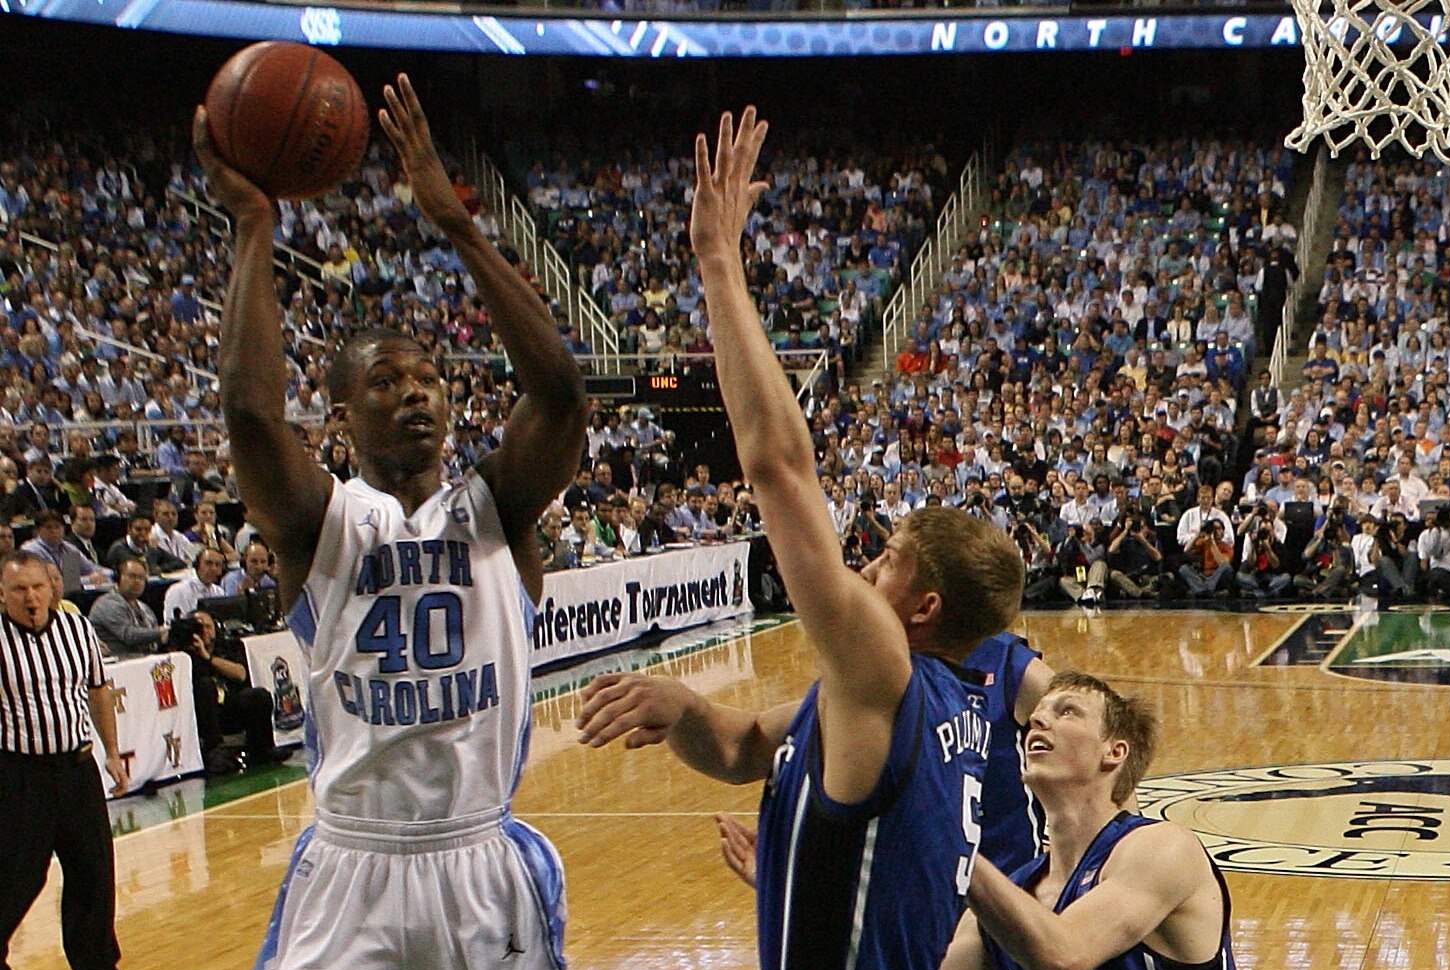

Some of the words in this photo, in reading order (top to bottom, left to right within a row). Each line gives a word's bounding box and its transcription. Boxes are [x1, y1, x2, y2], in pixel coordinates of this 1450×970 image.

[931, 18, 1157, 50] NORTH
[651, 376, 678, 389] UNC
[356, 539, 473, 596] NORTH
[356, 592, 465, 674] 40
[532, 597, 622, 650] nference
[334, 662, 500, 726] CAROLINA
[936, 709, 991, 763] PLUML
[955, 773, 983, 896] 5
[1343, 801, 1444, 841] ACC
